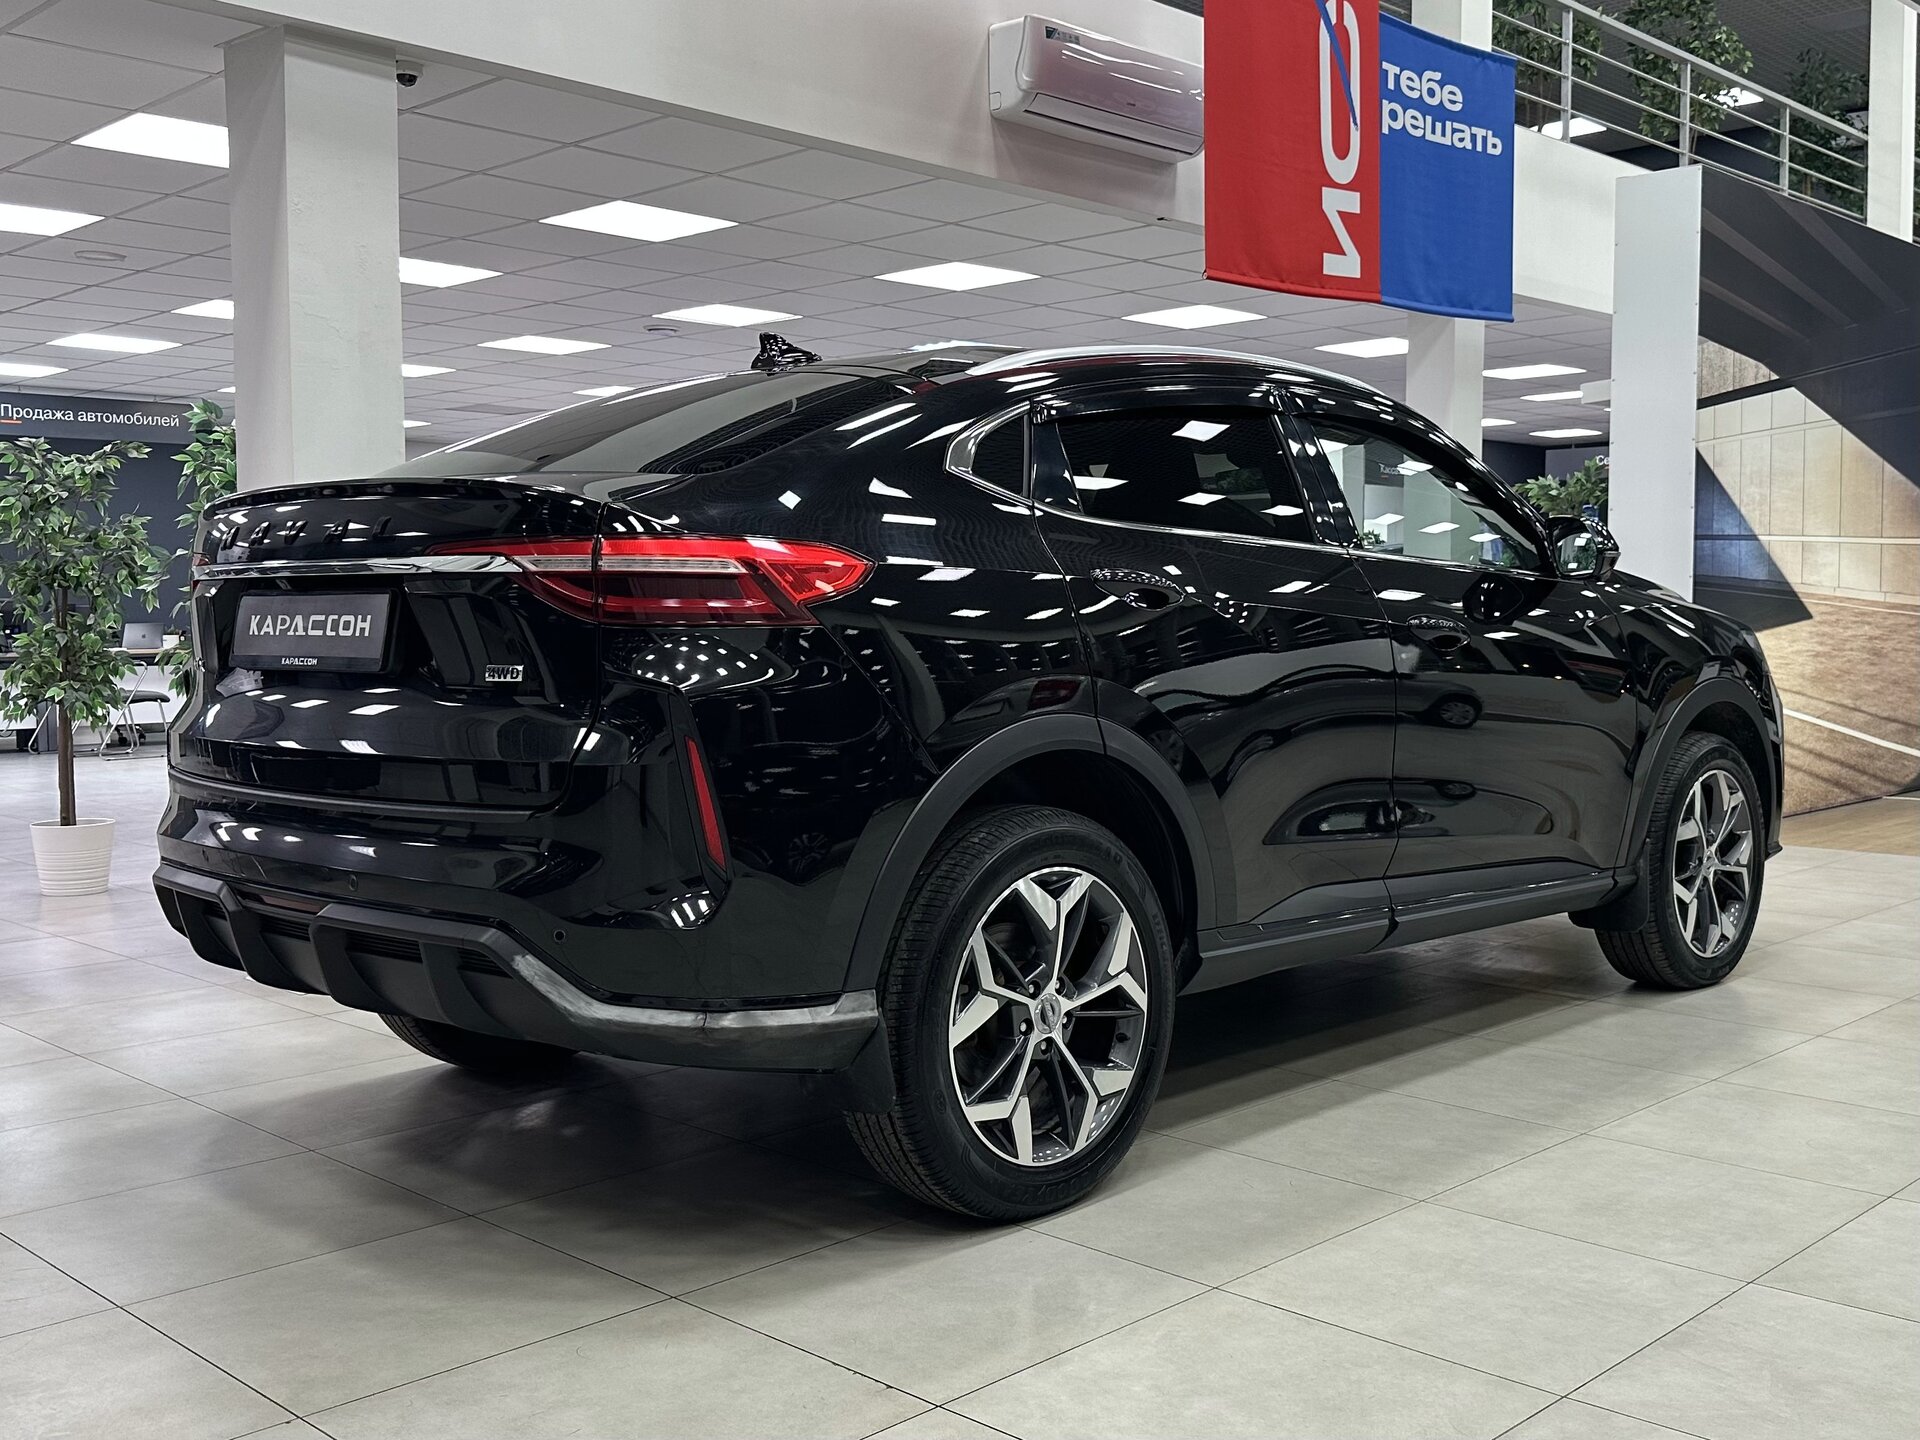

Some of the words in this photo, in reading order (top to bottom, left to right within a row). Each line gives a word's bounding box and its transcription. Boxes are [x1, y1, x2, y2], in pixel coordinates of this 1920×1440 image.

[1382, 61, 1463, 112] тебе
[1381, 99, 1503, 156] решать
[0, 403, 74, 420] Продажа
[77, 409, 180, 427] автомобилей
[221, 516, 396, 551] HAVAL
[487, 666, 521, 681] 4WD
